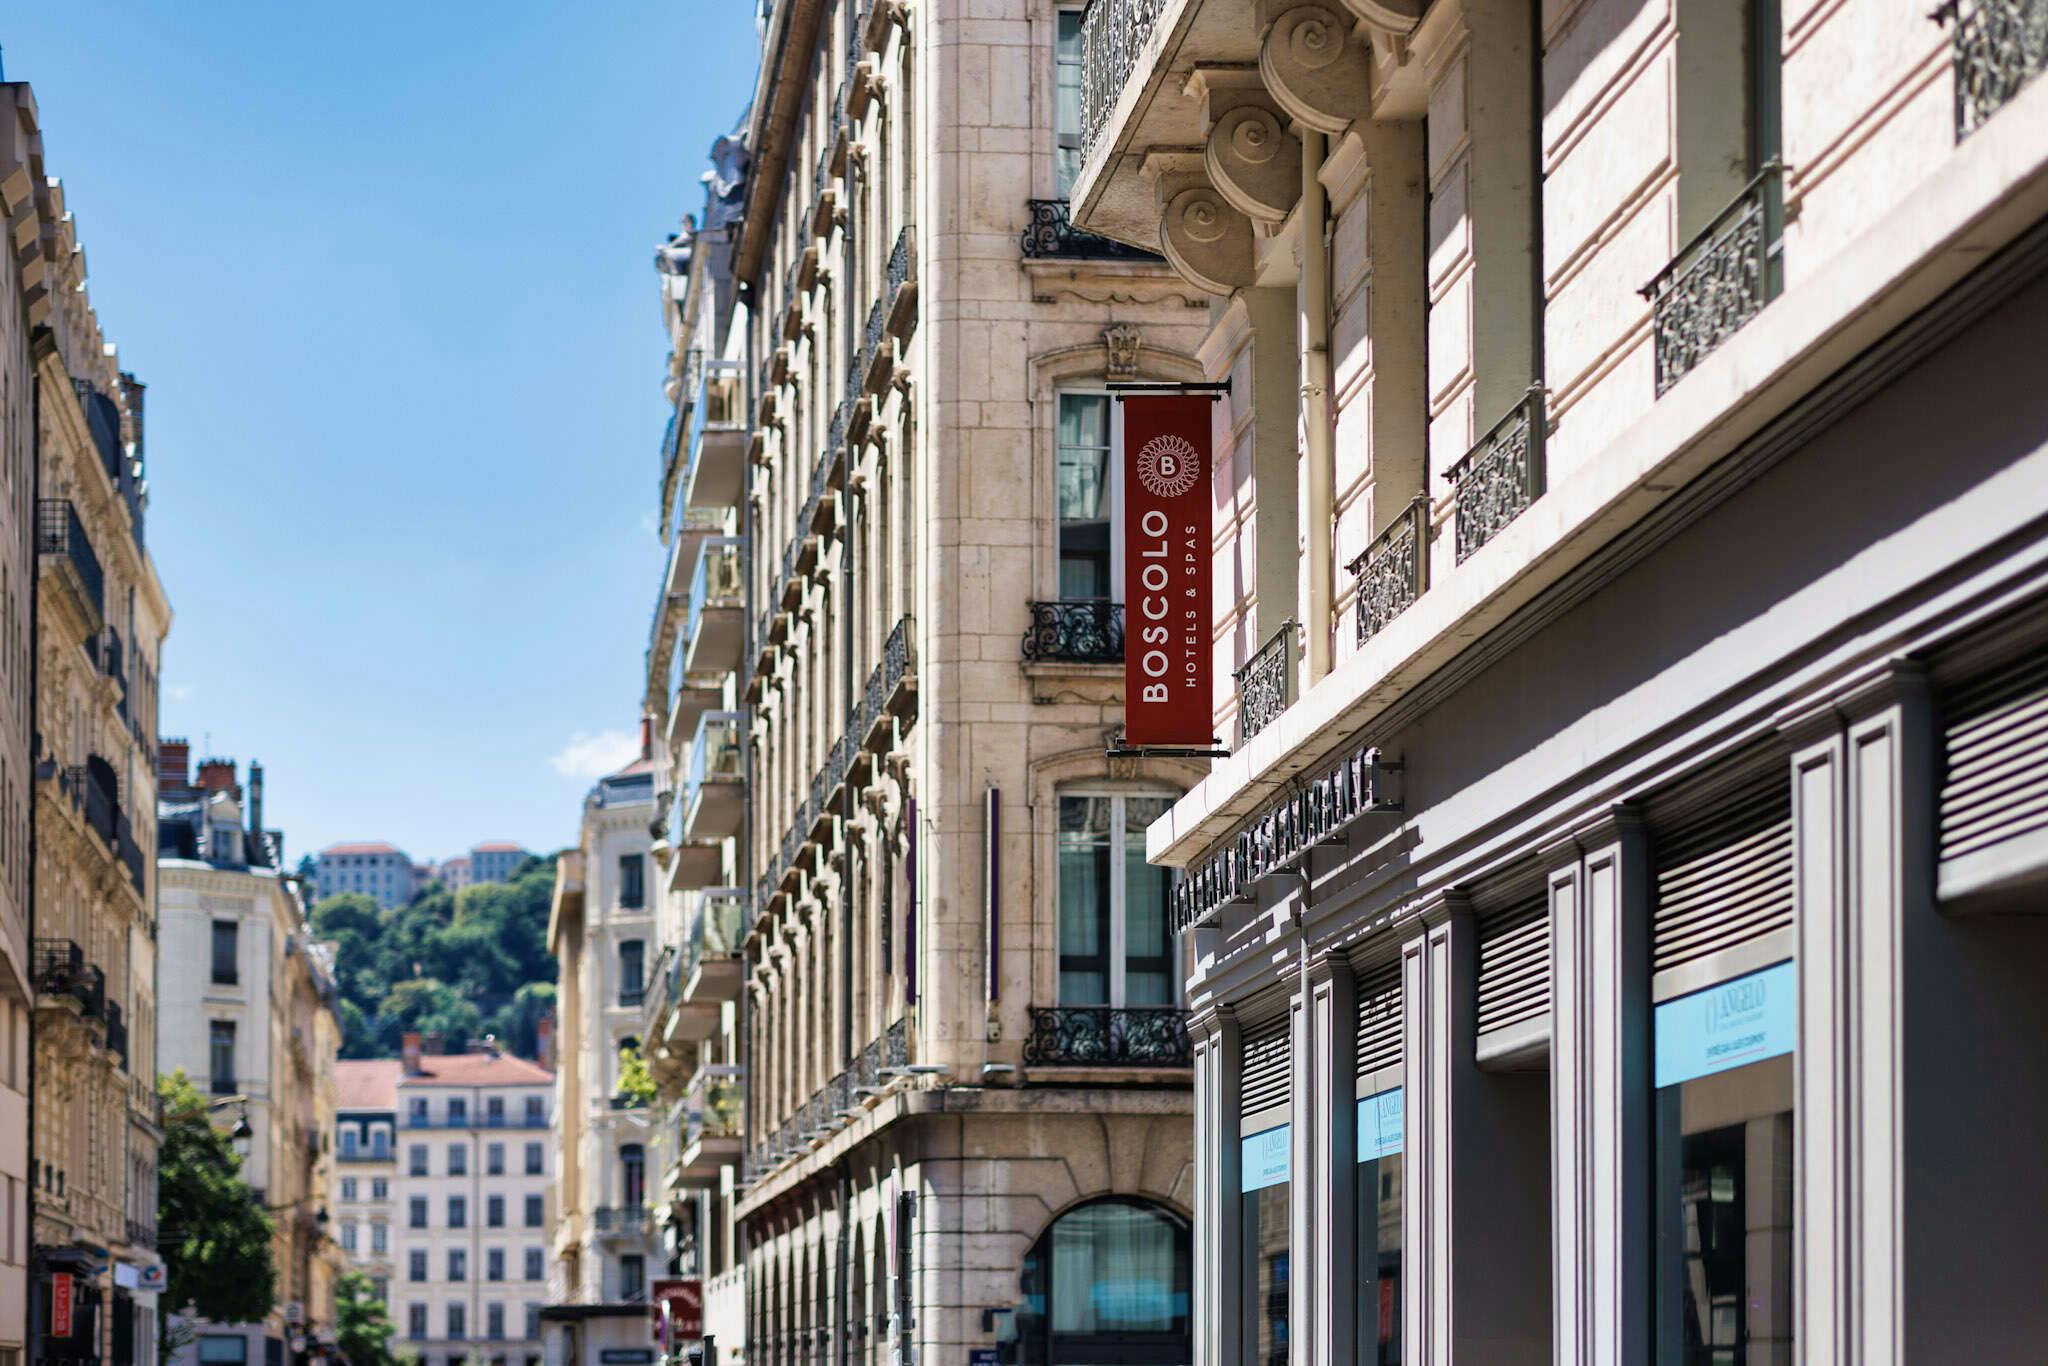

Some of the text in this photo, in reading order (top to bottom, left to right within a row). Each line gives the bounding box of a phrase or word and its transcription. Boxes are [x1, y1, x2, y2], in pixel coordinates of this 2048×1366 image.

[1161, 456, 1176, 475] B
[1141, 510, 1169, 703] BOSCOLO
[1185, 525, 1197, 688] HOTELS & SPAS
[1237, 746, 1381, 882] RESTAURANT
